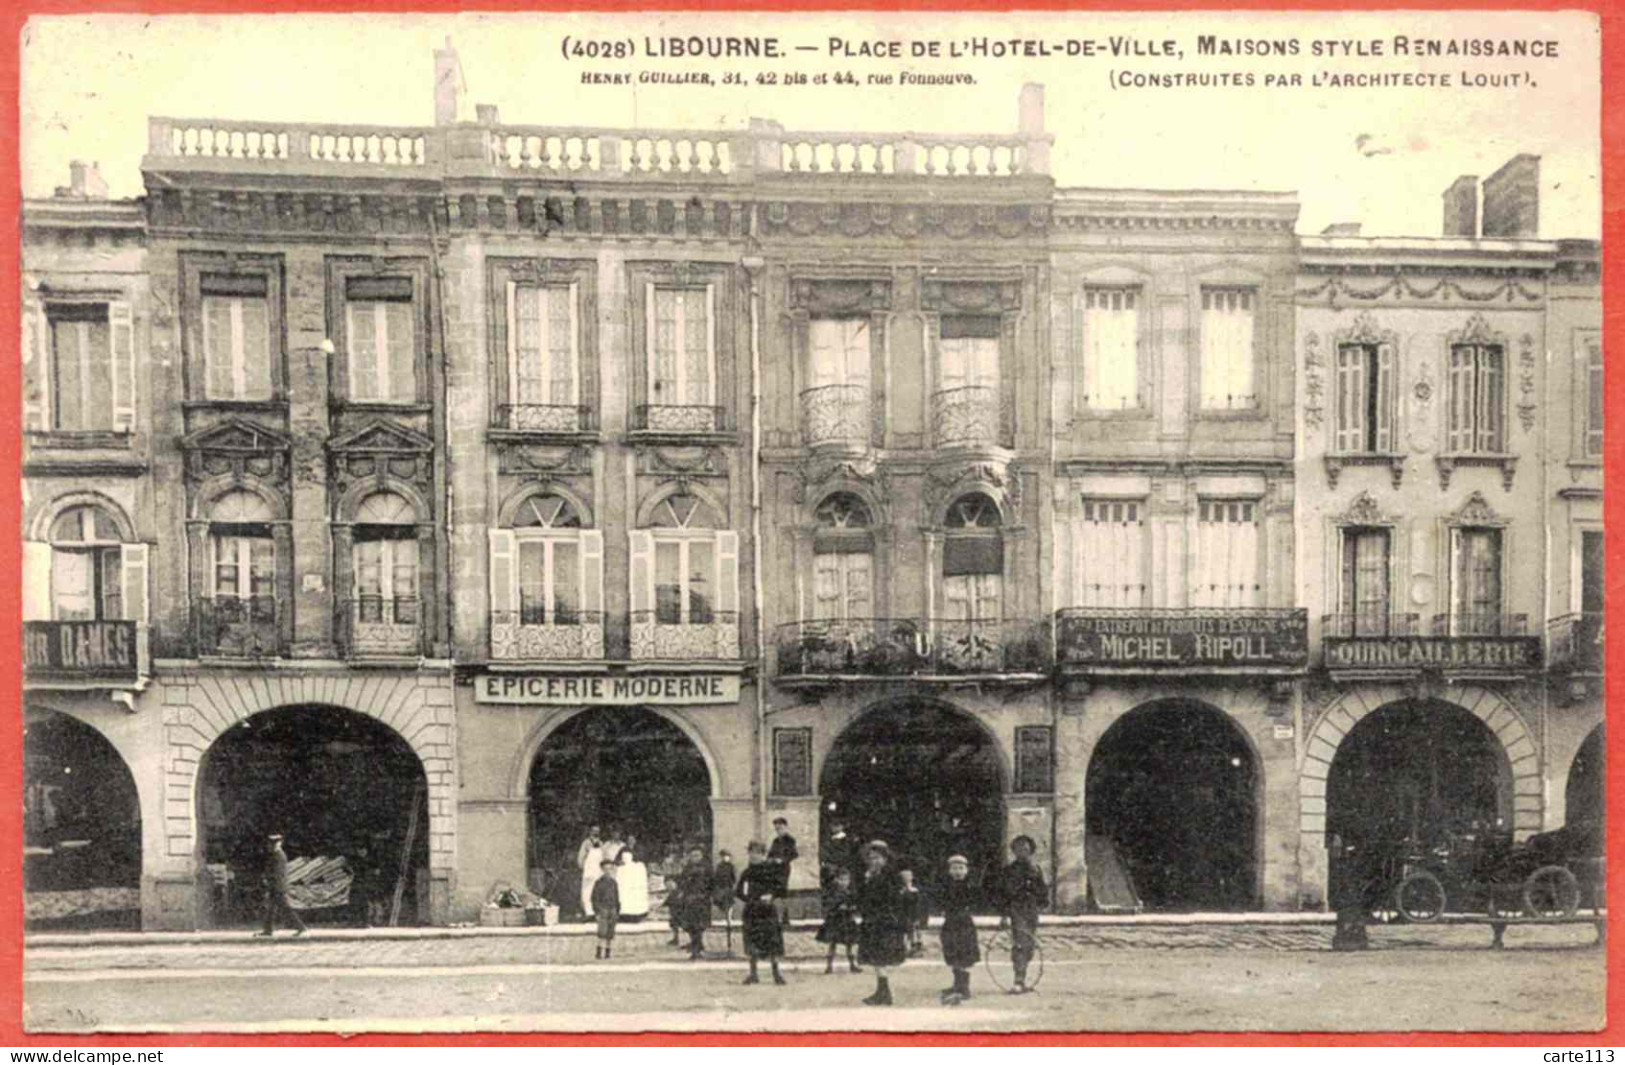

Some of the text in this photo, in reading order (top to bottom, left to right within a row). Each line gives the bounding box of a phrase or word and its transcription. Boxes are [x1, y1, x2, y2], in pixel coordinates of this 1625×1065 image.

[562, 36, 635, 59] (4028)
[645, 36, 785, 58] LIBOURNE.
[829, 37, 901, 57] PLACE
[912, 41, 940, 57] DE
[950, 37, 1183, 59] L'HOTEL-DE-VILLE,
[1198, 36, 1299, 56] MAISONS
[1312, 40, 1383, 56] STYLE
[1394, 36, 1558, 57] RENAISSANCE
[581, 72, 630, 84] HENRY
[639, 72, 715, 86] GUILLIER,
[756, 73, 777, 85] 42
[784, 72, 807, 85] bis
[813, 73, 827, 84] et
[833, 72, 859, 86] 44,
[868, 74, 892, 84] rue
[1110, 70, 1536, 89] (CONSTRUITES PAR L'ARCHITECTE LOUIT).
[60, 624, 129, 667] DAMES
[1099, 634, 1180, 660] MICHEL
[1195, 633, 1273, 660] RIPOLL
[1337, 639, 1527, 664] QUINCAILLERIE
[486, 677, 724, 698] EPICERIE MODERNE
